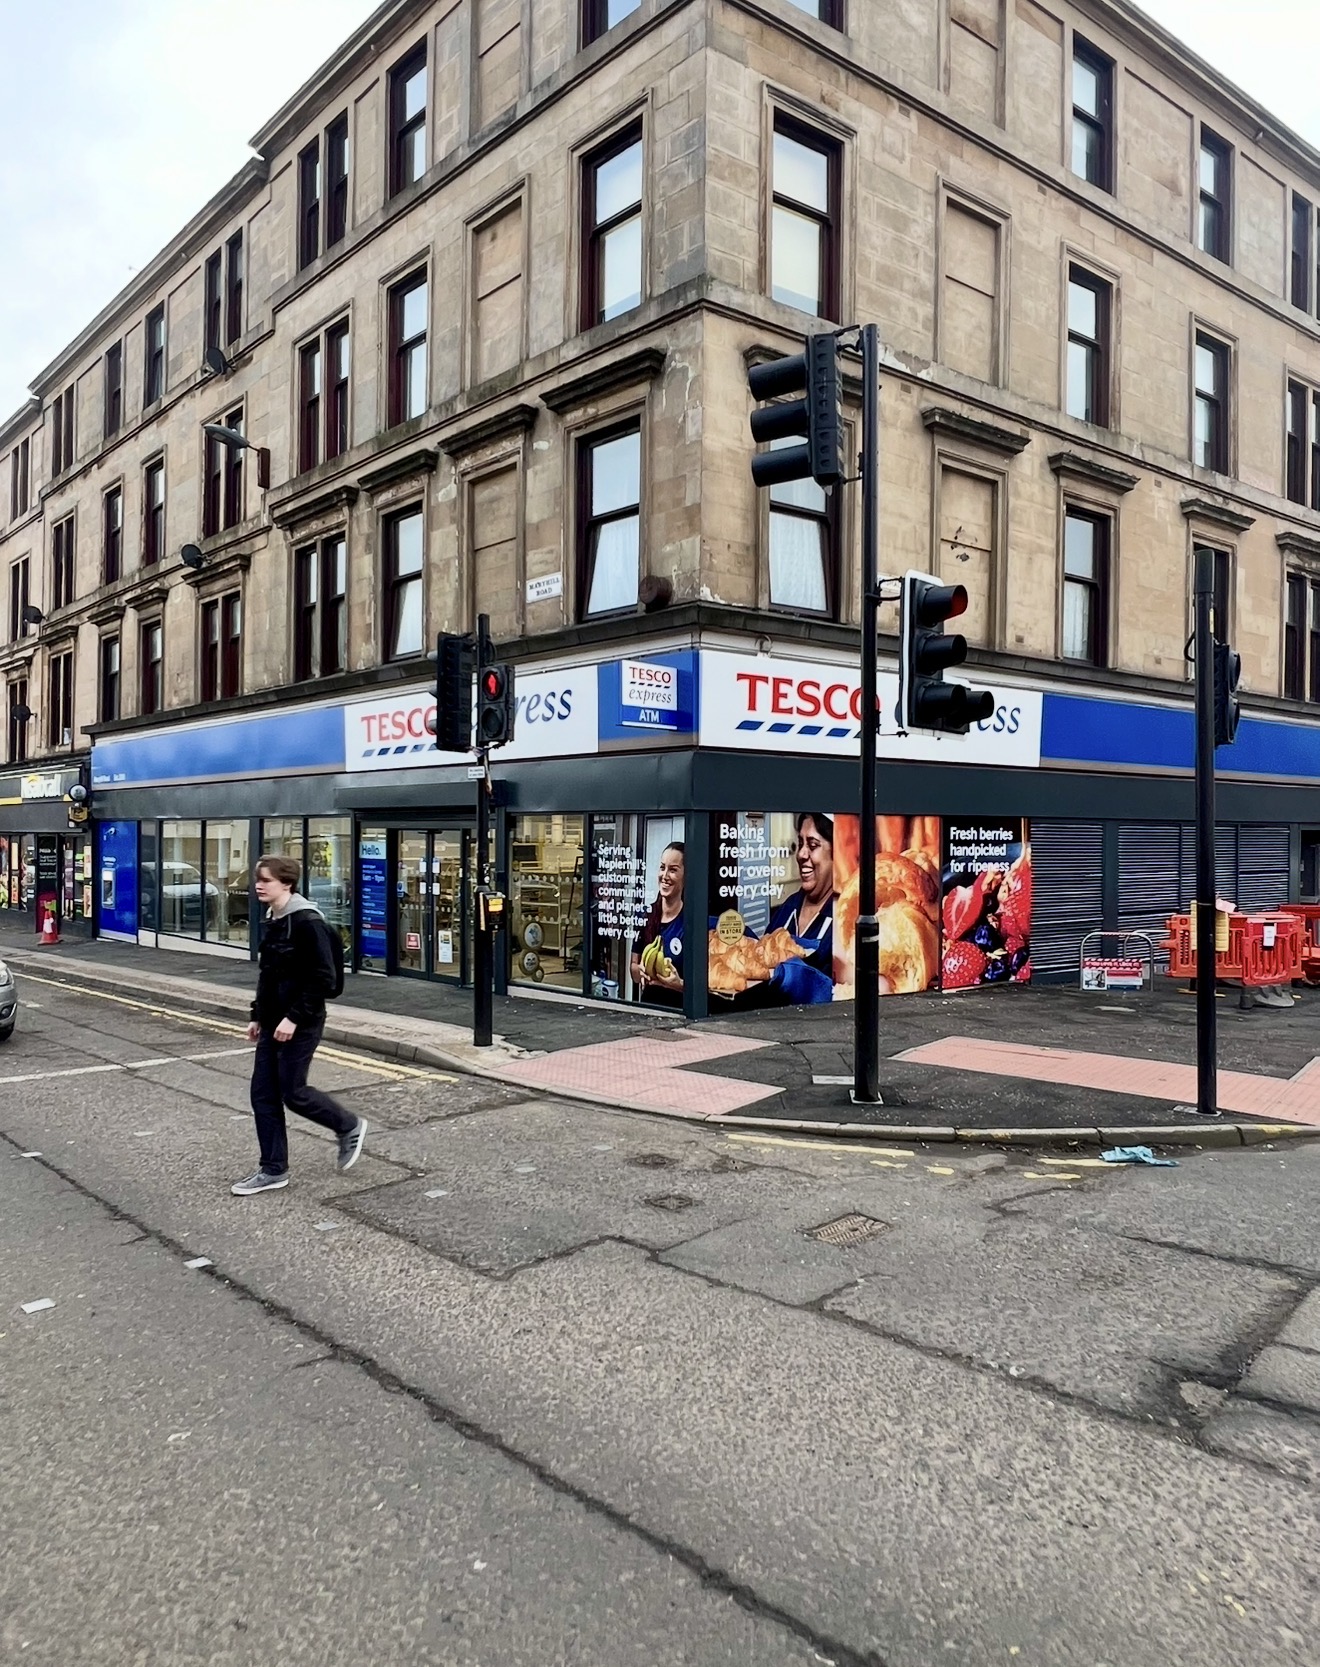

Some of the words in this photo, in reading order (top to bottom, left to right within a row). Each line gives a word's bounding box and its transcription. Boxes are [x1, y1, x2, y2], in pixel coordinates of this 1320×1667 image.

[529, 577, 559, 590] MARYHILL
[536, 587, 553, 596] ROAD
[629, 666, 671, 684] TESCO
[628, 688, 672, 704] express
[639, 709, 660, 723] ATM
[719, 823, 765, 843] Baking
[950, 826, 978, 840] Fresh
[979, 826, 1014, 841] berries
[598, 844, 631, 858] Serving
[719, 843, 754, 858] fresh
[757, 843, 789, 858] from
[950, 843, 1007, 860] handpicked
[719, 866, 744, 878] our
[746, 865, 786, 878] ovens
[950, 859, 966, 873] for
[967, 859, 1010, 876] ripeness
[598, 887, 655, 899] communities
[719, 885, 758, 900] every
[598, 899, 614, 910] and
[616, 900, 645, 913] planet
[646, 904, 653, 913] a
[598, 912, 618, 923] little
[619, 913, 648, 927] better
[598, 926, 622, 940] every
